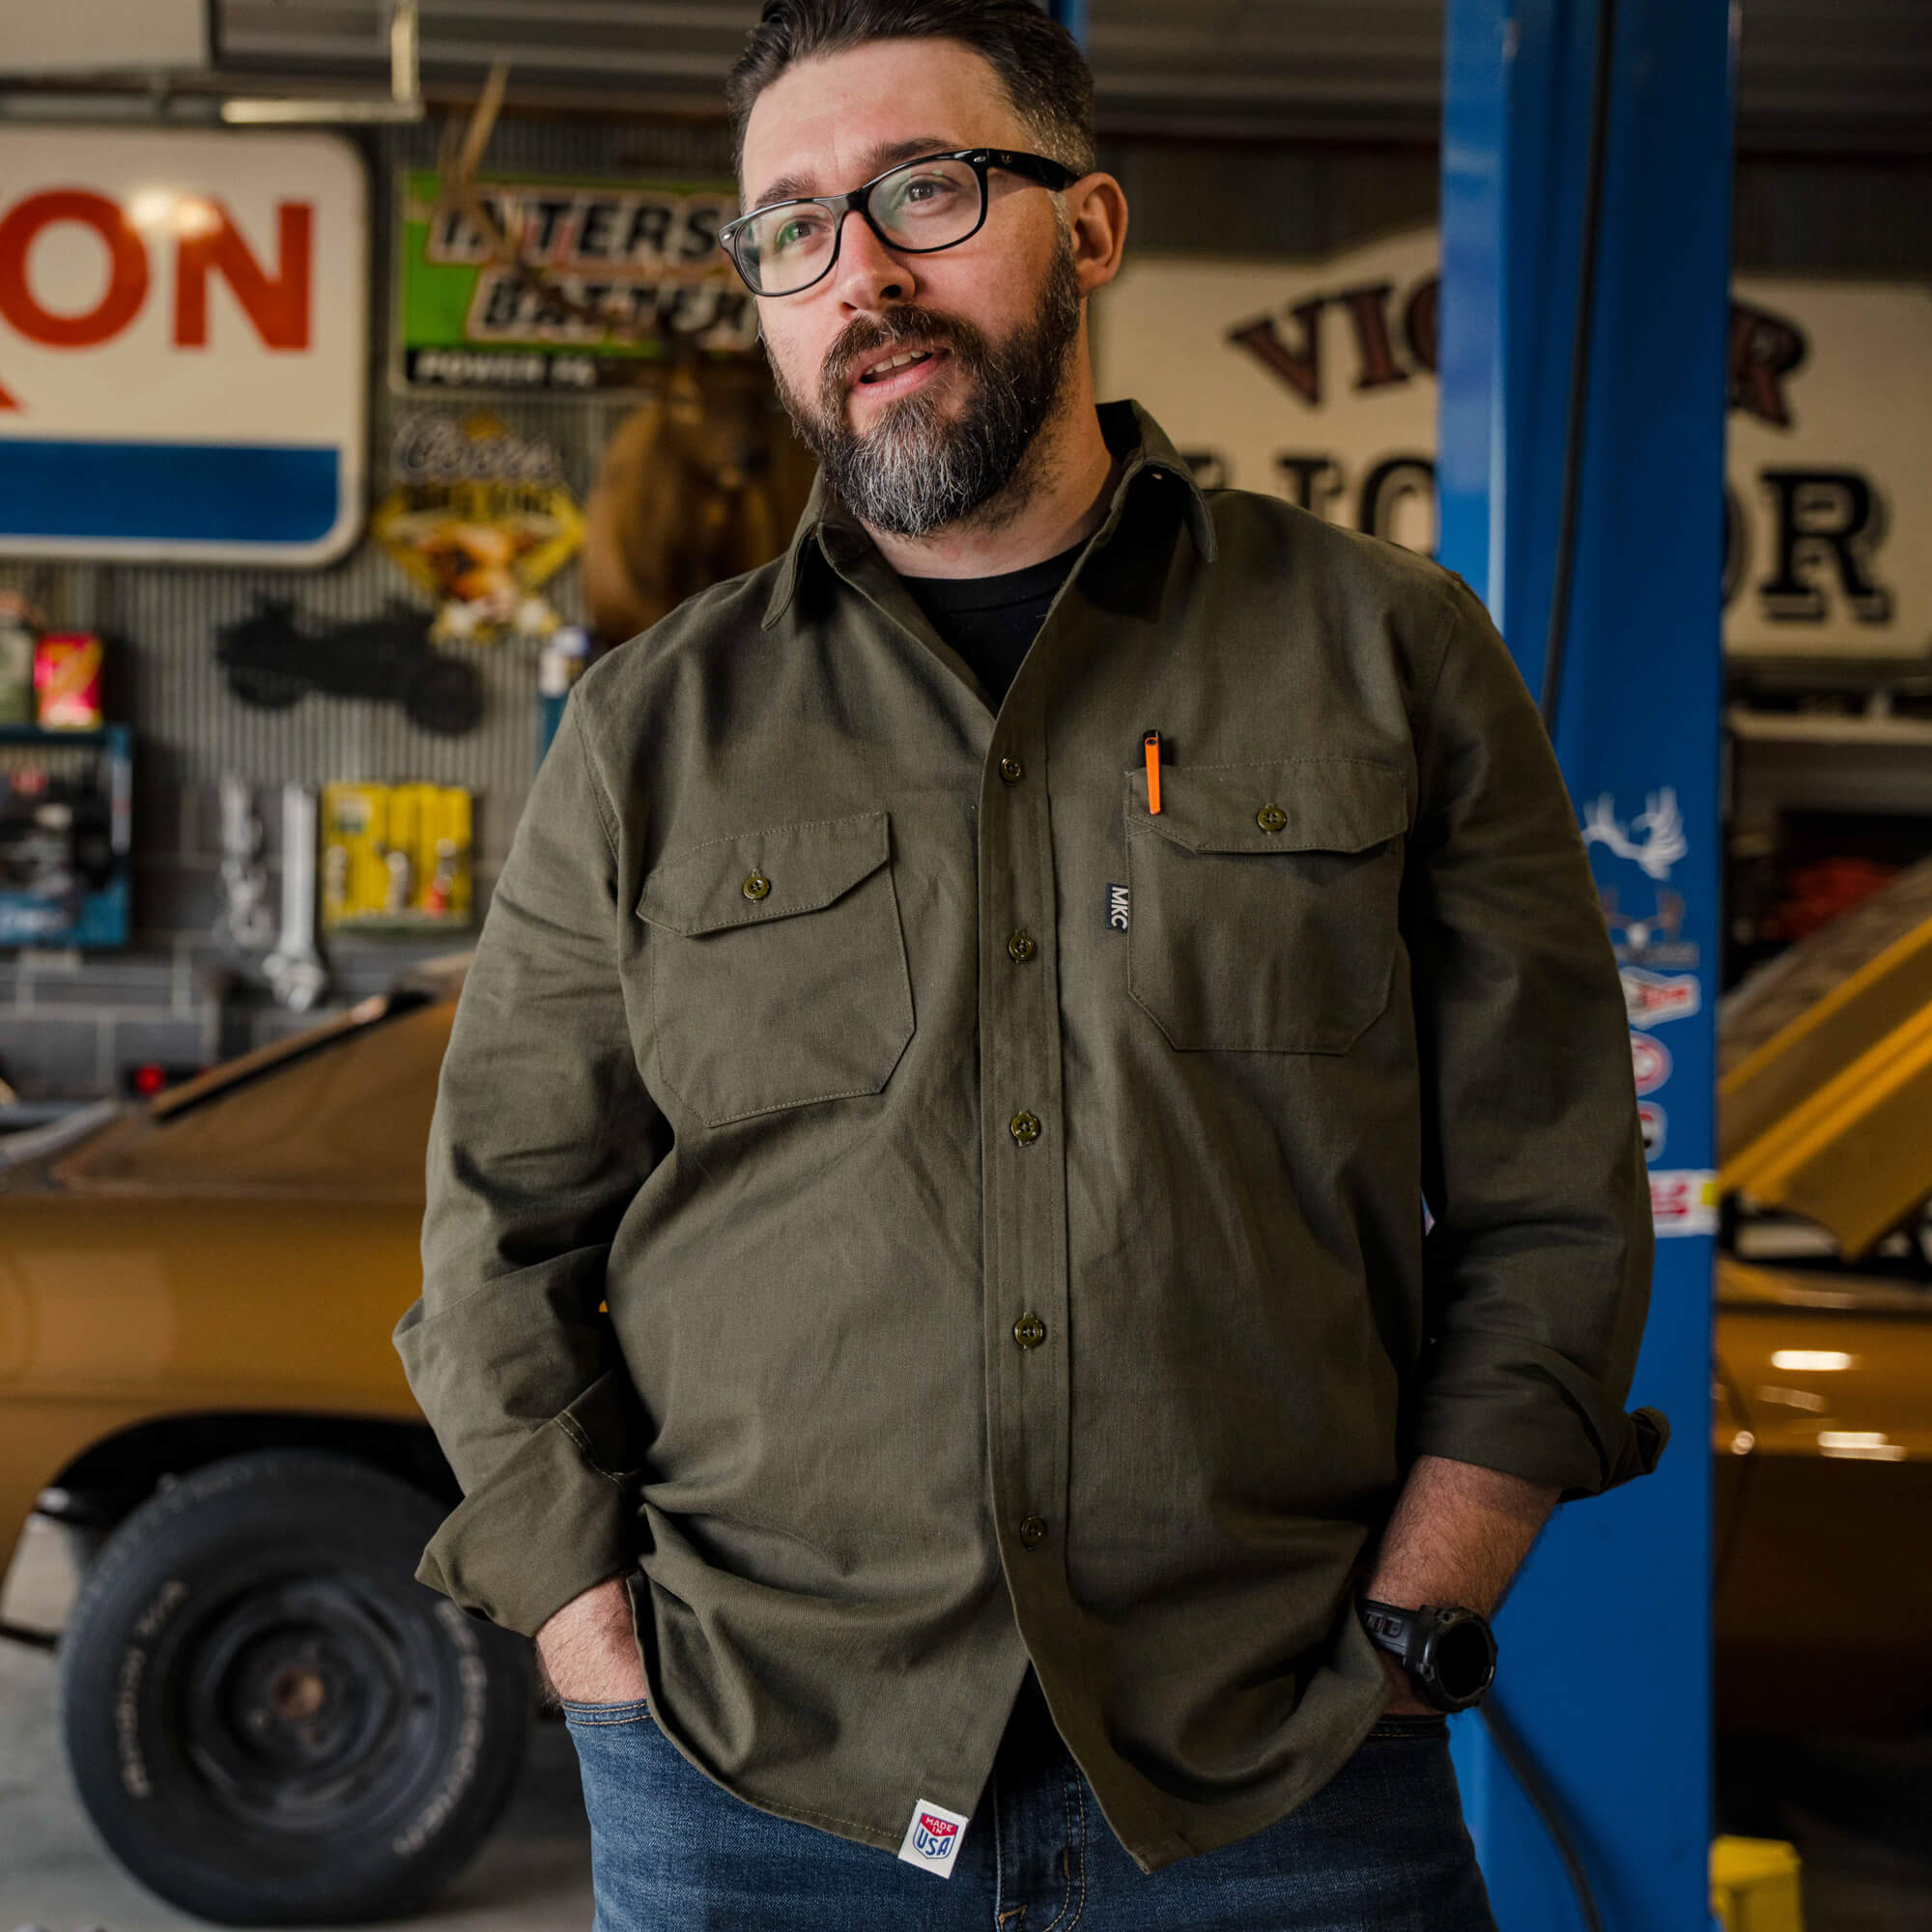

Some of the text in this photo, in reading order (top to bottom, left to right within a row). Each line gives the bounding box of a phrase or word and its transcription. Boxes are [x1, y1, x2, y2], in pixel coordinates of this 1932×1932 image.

[1111, 886, 1129, 929] MKC
[925, 1817, 953, 1832] MADE
[931, 1826, 944, 1834] IN
[916, 1828, 952, 1856] USA
